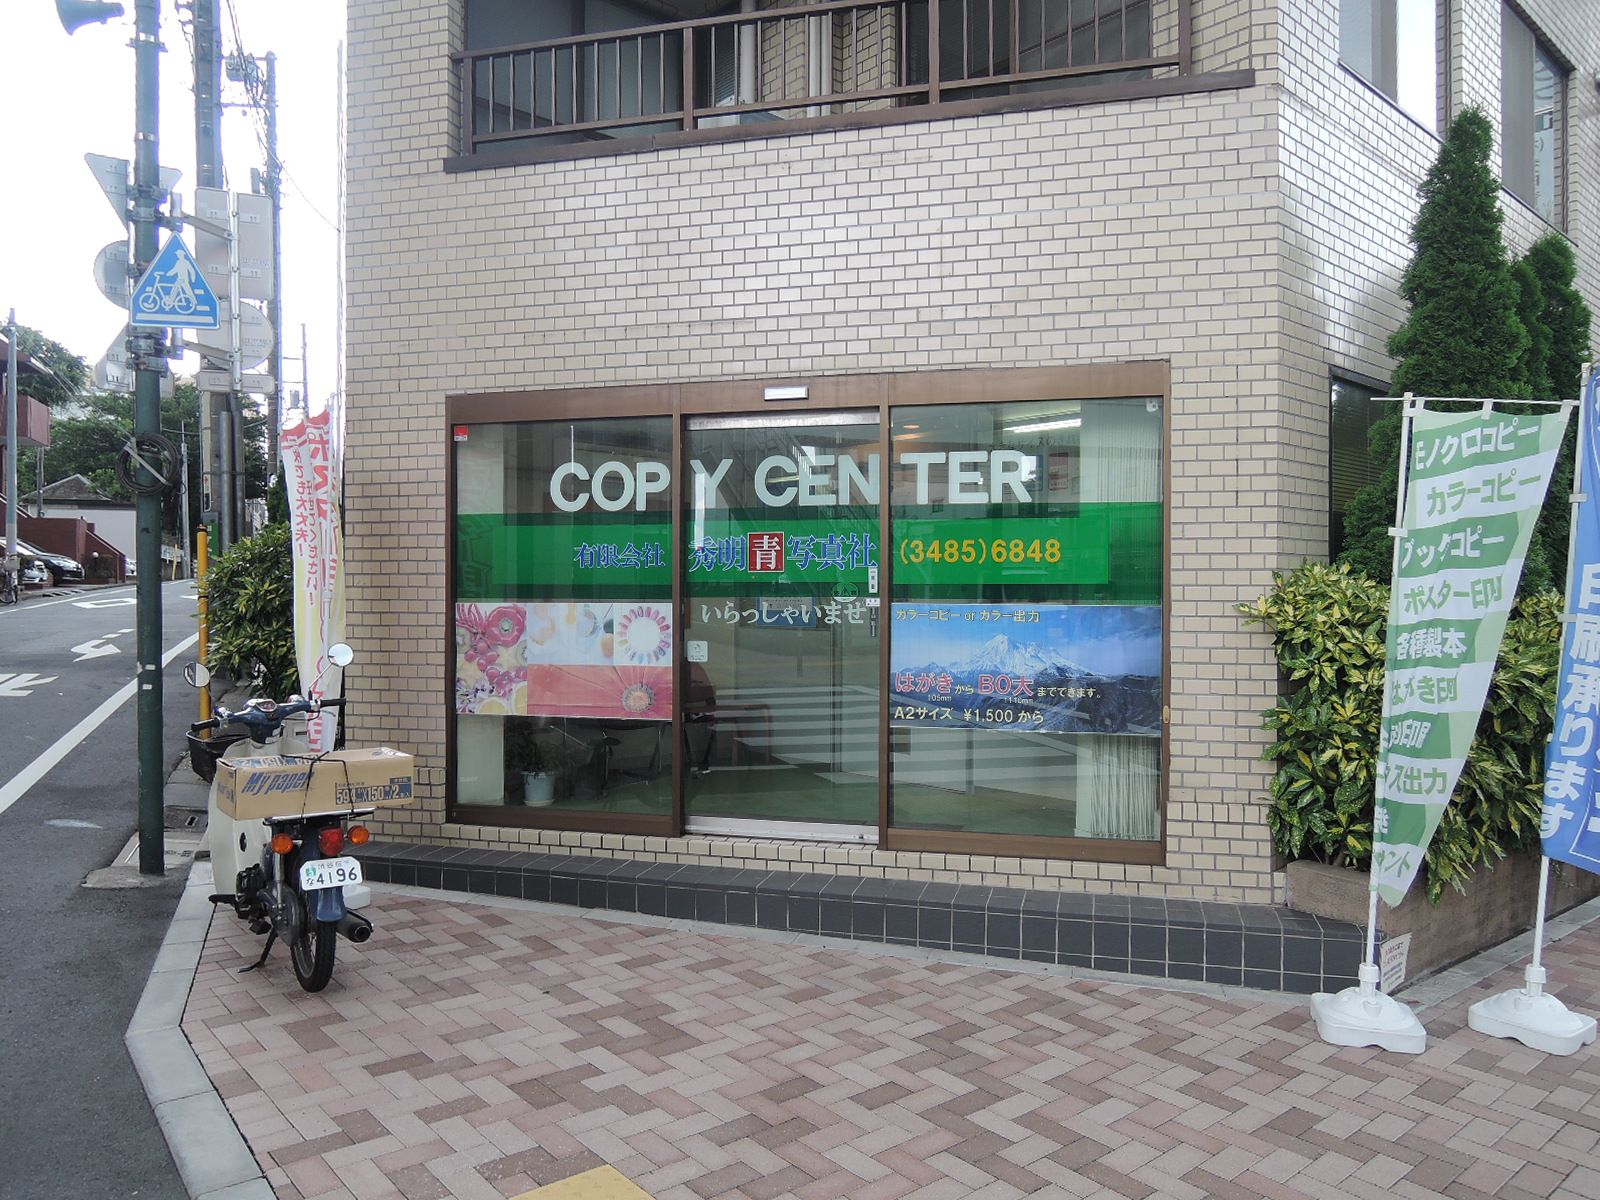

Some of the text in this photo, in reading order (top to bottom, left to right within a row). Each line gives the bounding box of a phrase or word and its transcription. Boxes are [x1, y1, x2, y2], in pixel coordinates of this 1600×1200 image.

[1415, 417, 1539, 470] モノクロコピー
[549, 457, 733, 512] COPY
[754, 450, 1033, 508] CENTER
[1427, 468, 1541, 518] カラーコピー
[574, 532, 1062, 572] 有限会社 秀明青写真社 (3485)6848
[700, 600, 867, 625] いらっしゃいませ
[895, 609, 1040, 623] カラーコピー or カラー出力
[895, 672, 953, 694] はがき
[955, 684, 974, 695] から
[1037, 686, 1101, 699] までできます。
[894, 706, 1044, 724] A2サイズ ¥1,500 から
[317, 867, 358, 885] 4196
